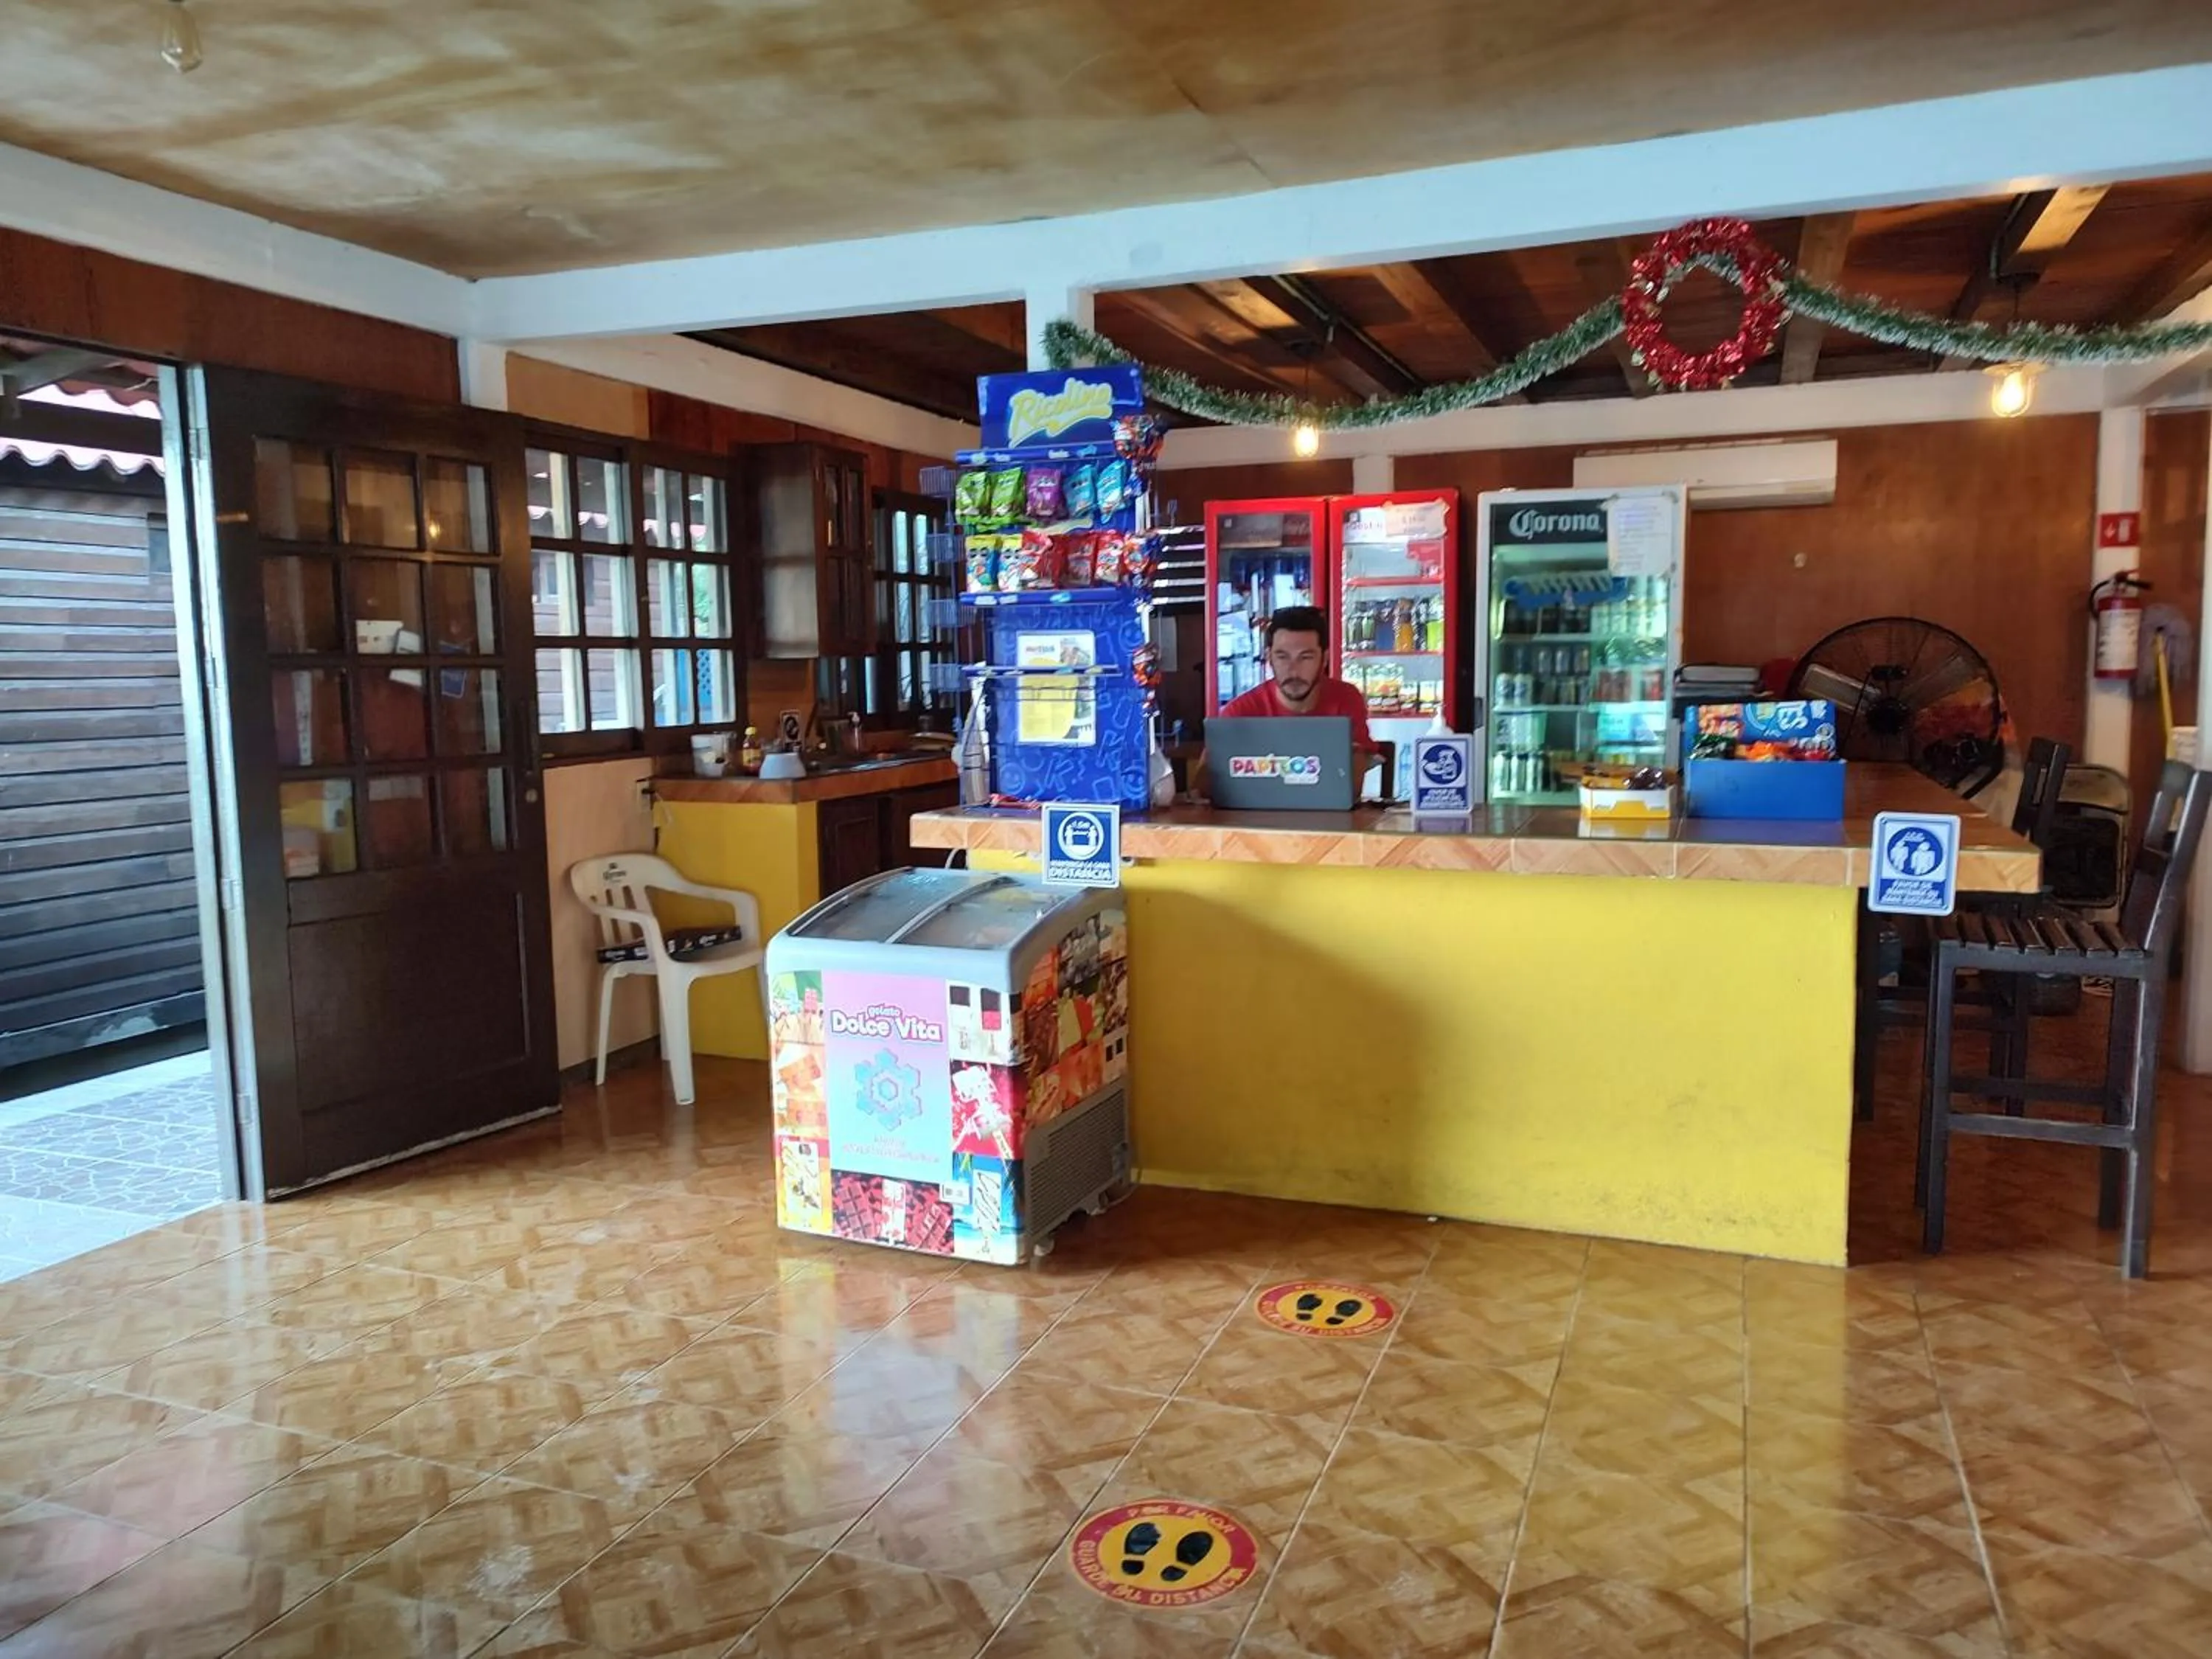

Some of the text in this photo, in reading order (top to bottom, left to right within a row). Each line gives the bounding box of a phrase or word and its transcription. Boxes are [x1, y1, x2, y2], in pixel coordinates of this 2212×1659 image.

[1509, 509, 1601, 540] Corona
[1049, 868, 1113, 880] DISTANCIA
[831, 1010, 942, 1041] Dolce Vita
[1175, 1506, 1237, 1534] FAVOR
[1077, 1539, 1112, 1590] GUARDE
